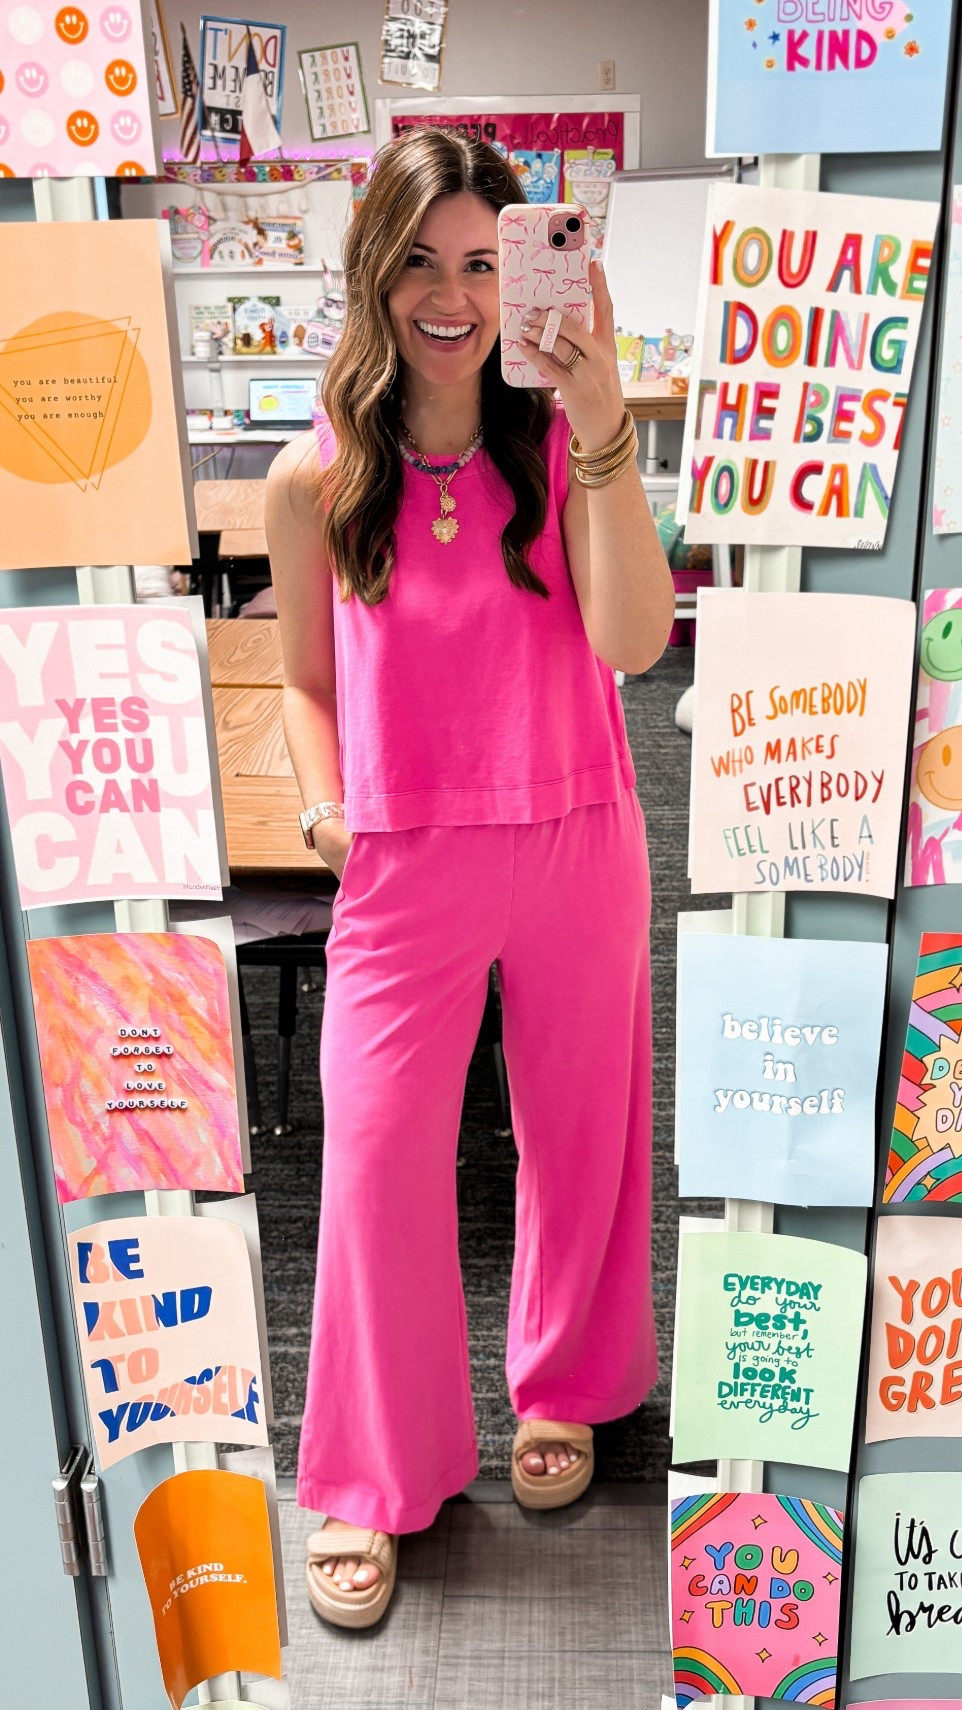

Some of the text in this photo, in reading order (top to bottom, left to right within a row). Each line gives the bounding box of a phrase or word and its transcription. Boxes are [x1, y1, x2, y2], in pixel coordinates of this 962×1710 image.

[786, 28, 878, 72] KIND
[710, 219, 933, 301] YOU ARE
[719, 300, 909, 375] DOING
[13, 379, 31, 387] you
[63, 376, 118, 385] beautiful
[15, 396, 33, 404] you
[65, 394, 102, 402] worthy
[67, 411, 104, 419] enough
[694, 379, 781, 442] THE
[689, 455, 891, 520] YOU CAN
[0, 619, 202, 707] YES
[54, 696, 150, 734] YES
[730, 690, 756, 737] BE
[58, 737, 155, 775] YOU
[710, 734, 839, 778] WHO MAKES
[65, 779, 161, 816] CAN
[743, 769, 885, 815] EVERYBODY
[12, 807, 222, 892] CAN
[722, 814, 874, 858] FEEL LIKE A
[120, 1028, 159, 1037] DONT
[721, 1013, 839, 1047] believe
[112, 1046, 171, 1055] FORGET
[136, 1063, 154, 1071] TO
[763, 1052, 797, 1083] in
[125, 1082, 164, 1090] LOVE
[713, 1088, 845, 1116] yourself
[106, 1099, 187, 1109] YOURSELF
[77, 1237, 144, 1284] BE
[723, 1273, 823, 1301] EVERYDAY
[730, 1289, 821, 1313] do your
[83, 1285, 213, 1342] KIND
[730, 1328, 748, 1338] but
[725, 1340, 815, 1361] your best
[738, 1353, 798, 1368] is going to
[90, 1347, 160, 1394] TO
[732, 1362, 797, 1384] look
[98, 1365, 260, 1444] YOURSELF
[717, 1381, 815, 1406] DIFFERENT
[717, 1398, 820, 1431] everyday
[704, 1541, 799, 1575] YOU
[169, 1562, 225, 1592] BE KIND
[688, 1573, 815, 1602] CAN DO
[894, 1571, 962, 1592] TO TAK
[161, 1573, 248, 1616] TO YOURSELF.
[705, 1597, 800, 1631] THIS
